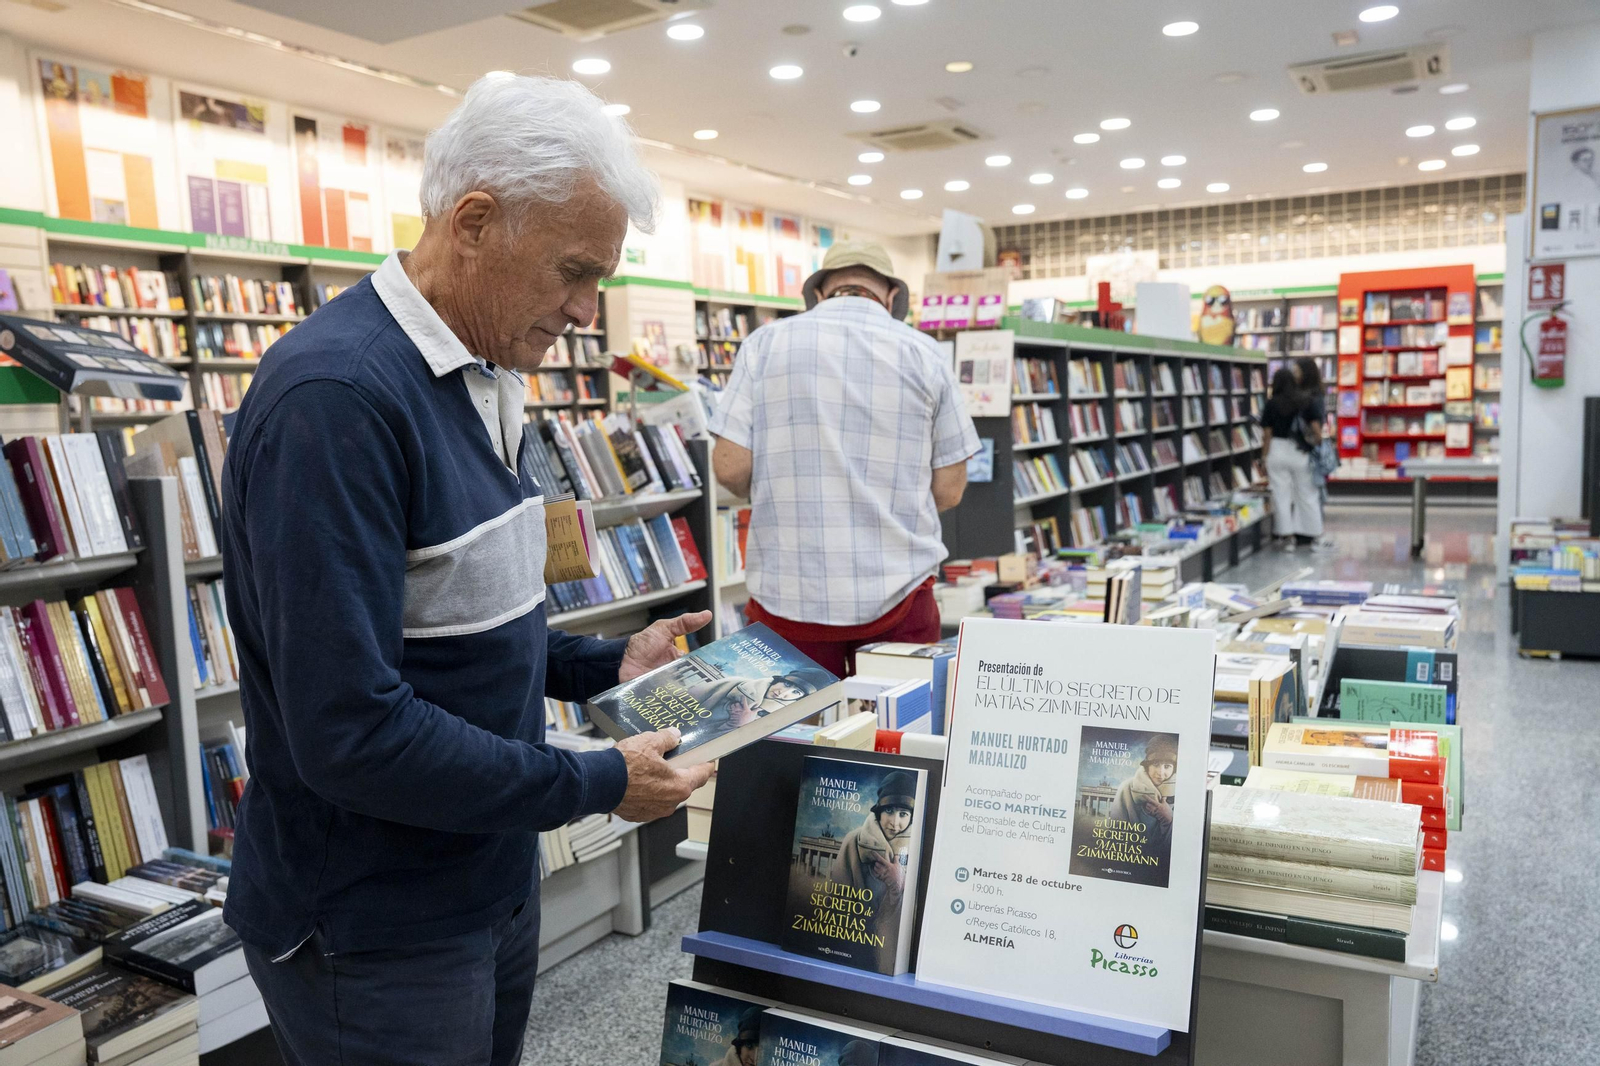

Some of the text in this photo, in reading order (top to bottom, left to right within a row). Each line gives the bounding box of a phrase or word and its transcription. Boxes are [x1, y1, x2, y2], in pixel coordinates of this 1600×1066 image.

[205, 232, 290, 257] NARRATIVA
[739, 639, 776, 667] HURTADO
[750, 637, 782, 662] MANUEL
[978, 660, 1044, 677] Presentación de
[976, 674, 1181, 705] EL ÚLTIMO SECRETO DE
[623, 689, 667, 731] ZIMMERM
[651, 686, 695, 721] SECRETO
[975, 693, 1151, 721] MATÍAS ZIMMERMANN
[970, 731, 1068, 755] MANUEL HURTADO
[1095, 740, 1129, 751] MANUEL
[968, 749, 1027, 770] MARJALIZO
[1089, 755, 1132, 767] MARJALIZO
[1092, 748, 1131, 759] HURTADO
[819, 776, 858, 791] MANUEL
[965, 784, 1042, 802] Acompañado por
[815, 786, 861, 802] HURTADO
[811, 796, 861, 813] MARJALIZO
[964, 798, 1067, 819] DIEGO MARTÍNEZ
[962, 811, 1066, 834] Responsable de Cultura
[1104, 817, 1147, 833] ÚLTIMO
[961, 824, 1055, 844] del Diario de Almería
[1092, 827, 1140, 843] SECRETO
[1228, 837, 1253, 846] VALLEJO
[1077, 844, 1159, 867] ZIMMERMANN
[1094, 838, 1142, 855] MATÍAS
[1229, 865, 1255, 873] VALLEJO
[971, 883, 1004, 896] 19:00 h.
[973, 867, 1083, 892] Martes 28 de octubre
[824, 879, 874, 902] ÚLTIMO
[809, 892, 864, 915] SECRETO
[968, 901, 1038, 920] Librerías Picasso
[811, 907, 867, 932] MATÍAS
[965, 917, 999, 931] c/Reyes
[1000, 921, 1041, 938] Católicos
[1264, 925, 1287, 934] INFINIT
[791, 914, 886, 949] ZIMMERMANN
[963, 932, 1015, 949] ALMERÍA
[1090, 948, 1158, 978] Picasso
[683, 1004, 720, 1023] MANUEL
[675, 1023, 723, 1044] MARJALIZO
[679, 1014, 722, 1034] HURTADO
[774, 1046, 821, 1066] HURTADO
[779, 1036, 819, 1057] MANUEL
